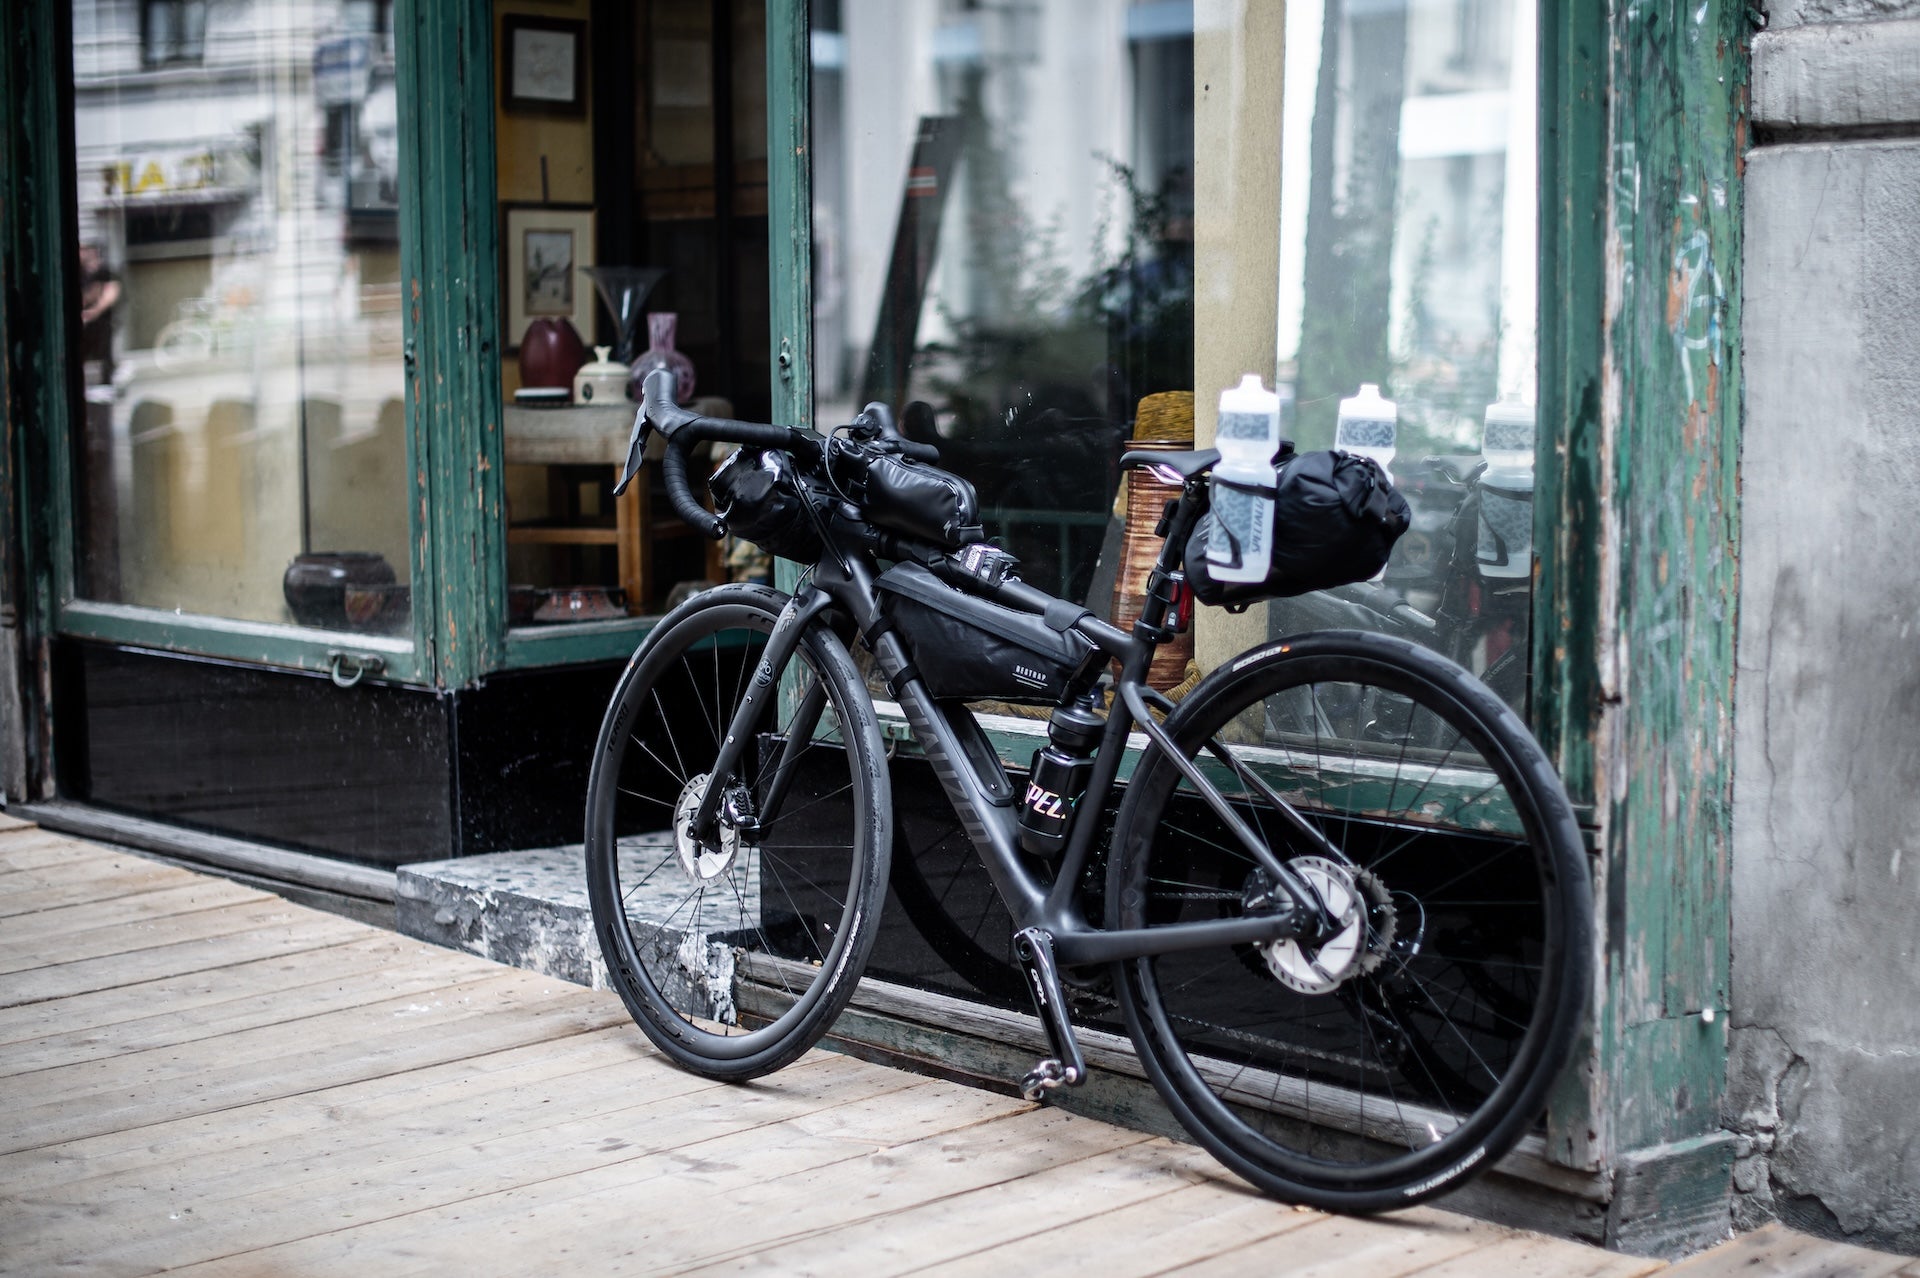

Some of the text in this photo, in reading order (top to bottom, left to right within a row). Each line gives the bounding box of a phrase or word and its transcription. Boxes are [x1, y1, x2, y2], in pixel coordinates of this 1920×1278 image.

[827, 910, 861, 994] CONTINENTAL
[1030, 967, 1047, 1005] GRX
[1403, 1146, 1486, 1197] CONTINENTAL
